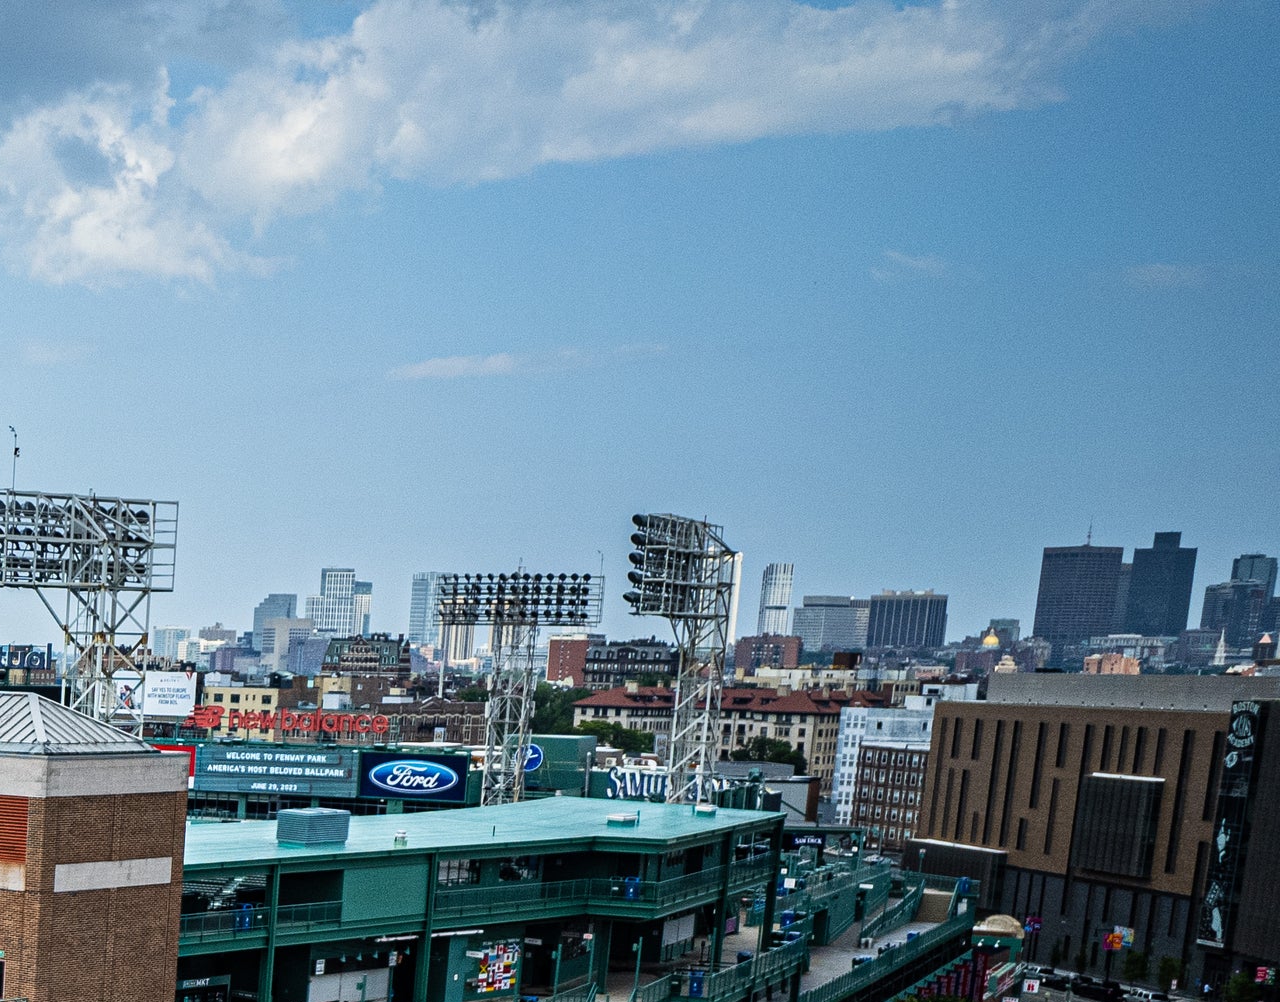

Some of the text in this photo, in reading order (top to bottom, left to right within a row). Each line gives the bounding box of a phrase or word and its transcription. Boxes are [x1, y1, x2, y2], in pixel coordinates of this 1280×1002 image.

[228, 710, 278, 730] new
[280, 706, 389, 734] balance
[226, 752, 261, 760] WELCOME
[275, 753, 304, 762] FENWAY
[307, 755, 327, 763] PARK
[207, 764, 344, 777] AMERICA'S MOST BELOVED BALLPARK
[386, 763, 441, 788] Ford
